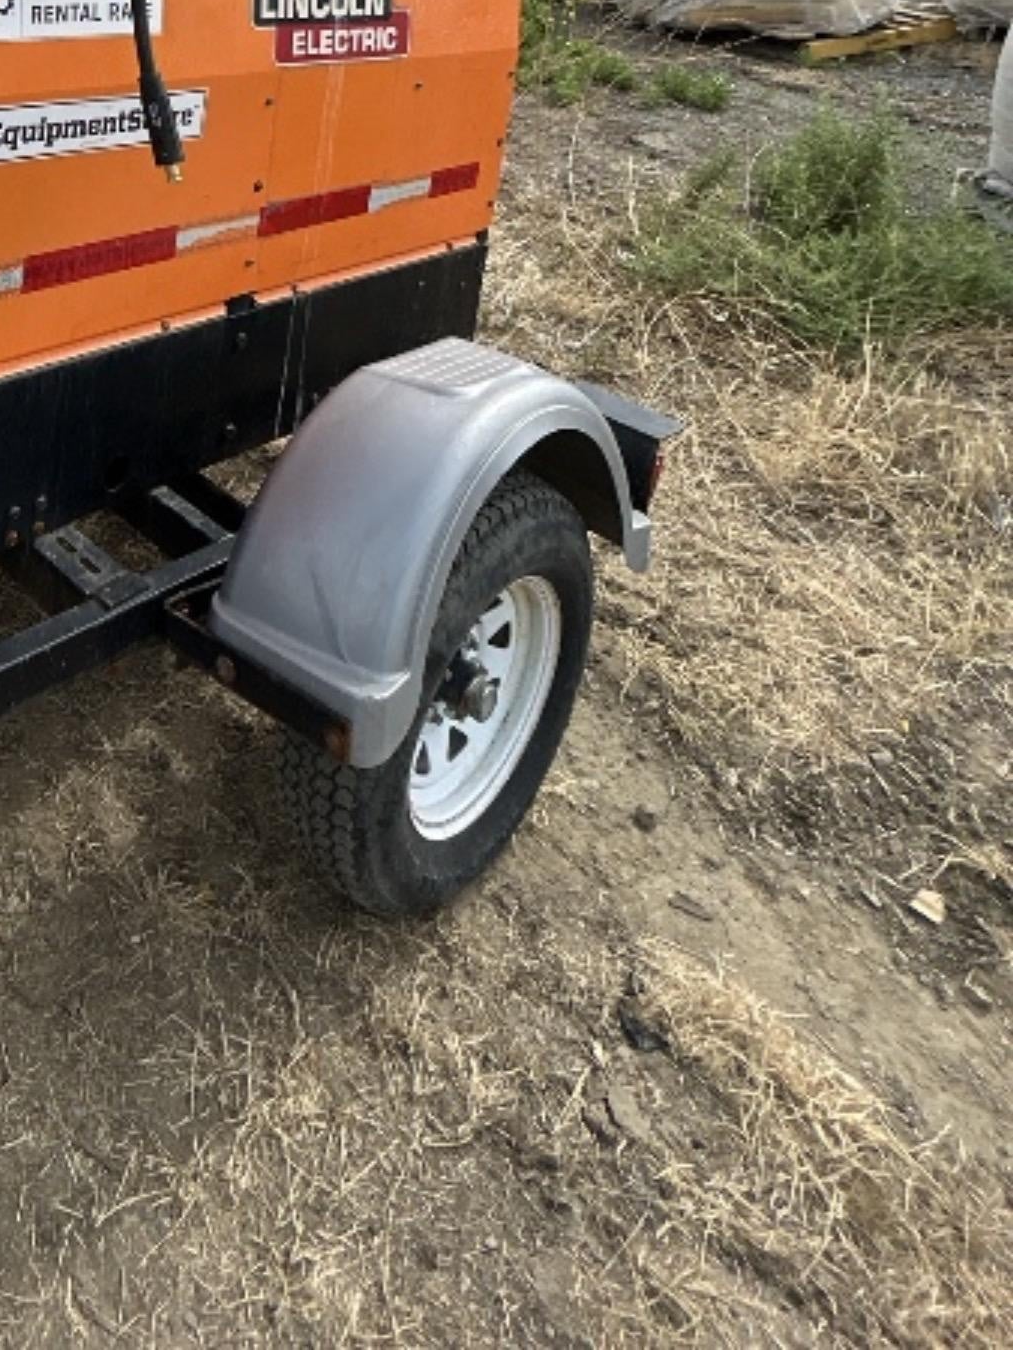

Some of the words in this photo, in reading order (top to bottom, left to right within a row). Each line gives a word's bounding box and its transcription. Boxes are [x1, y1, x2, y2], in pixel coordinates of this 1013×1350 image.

[31, 2, 102, 24] RENTAL
[109, 1, 153, 22] RAE
[292, 26, 399, 56] ELECTRIC
